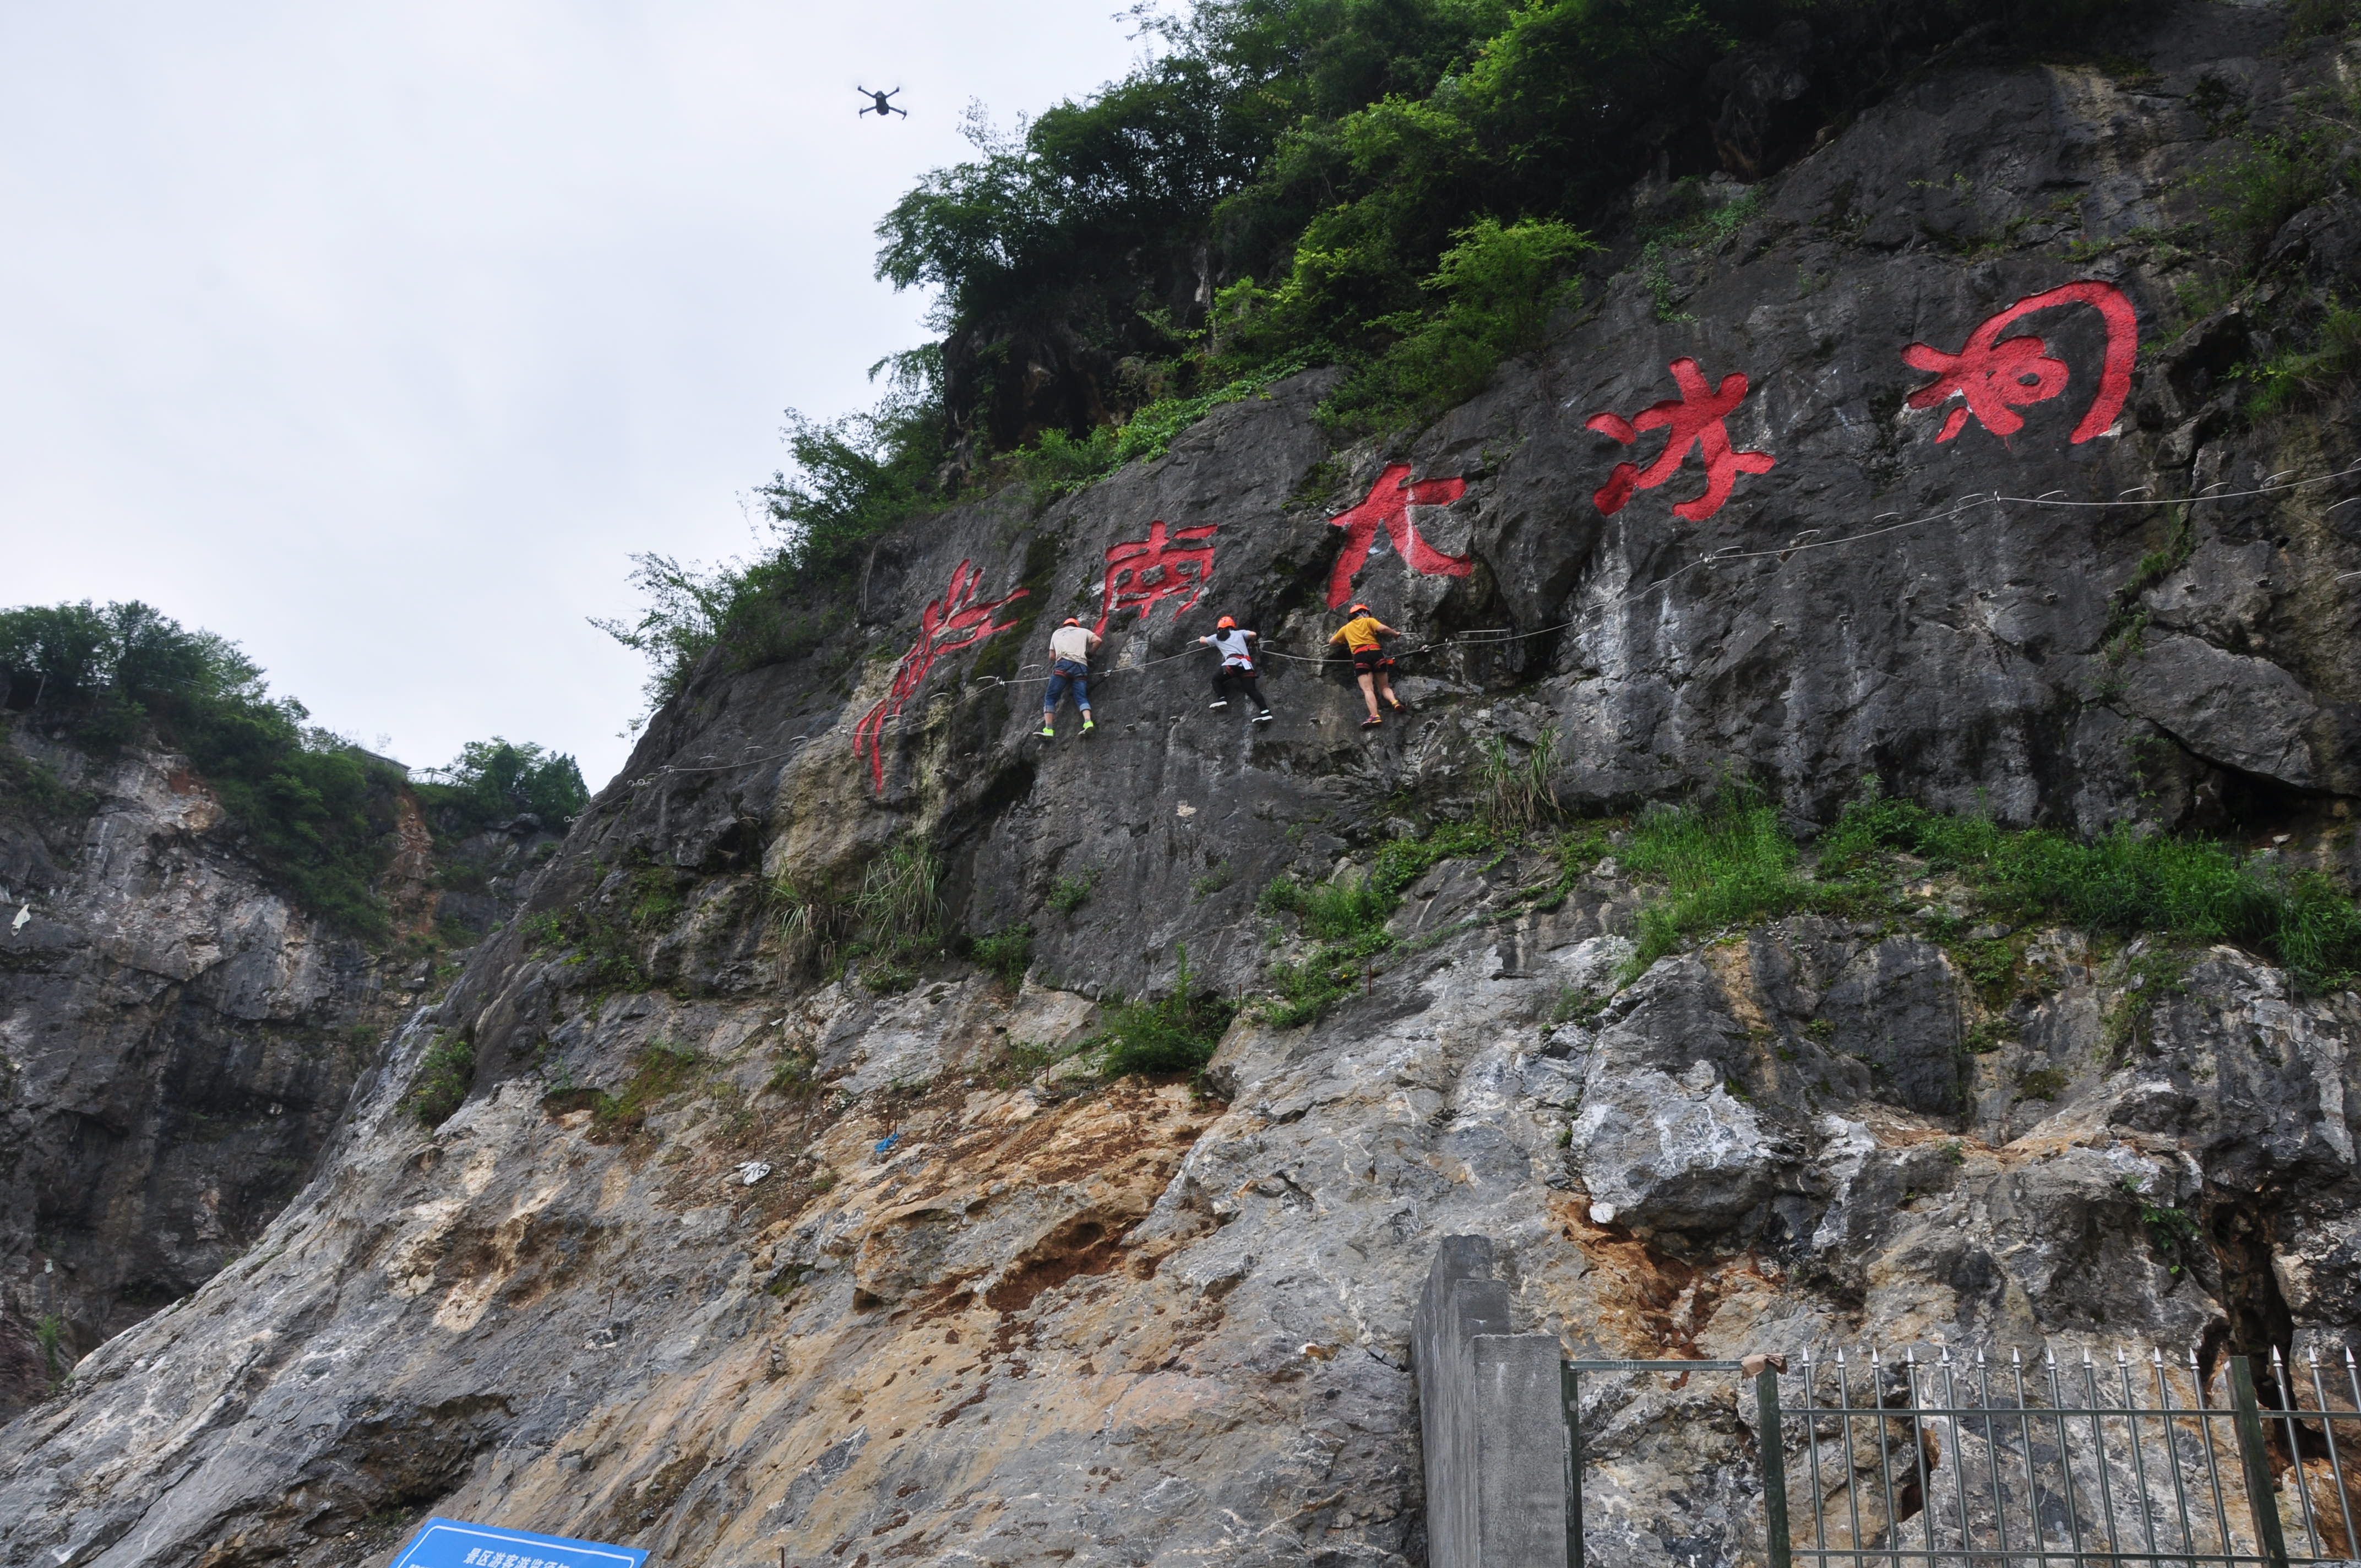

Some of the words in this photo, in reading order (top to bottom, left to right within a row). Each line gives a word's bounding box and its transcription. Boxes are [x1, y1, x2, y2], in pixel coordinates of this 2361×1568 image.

[463, 1548, 570, 1568] 景区游客游览
